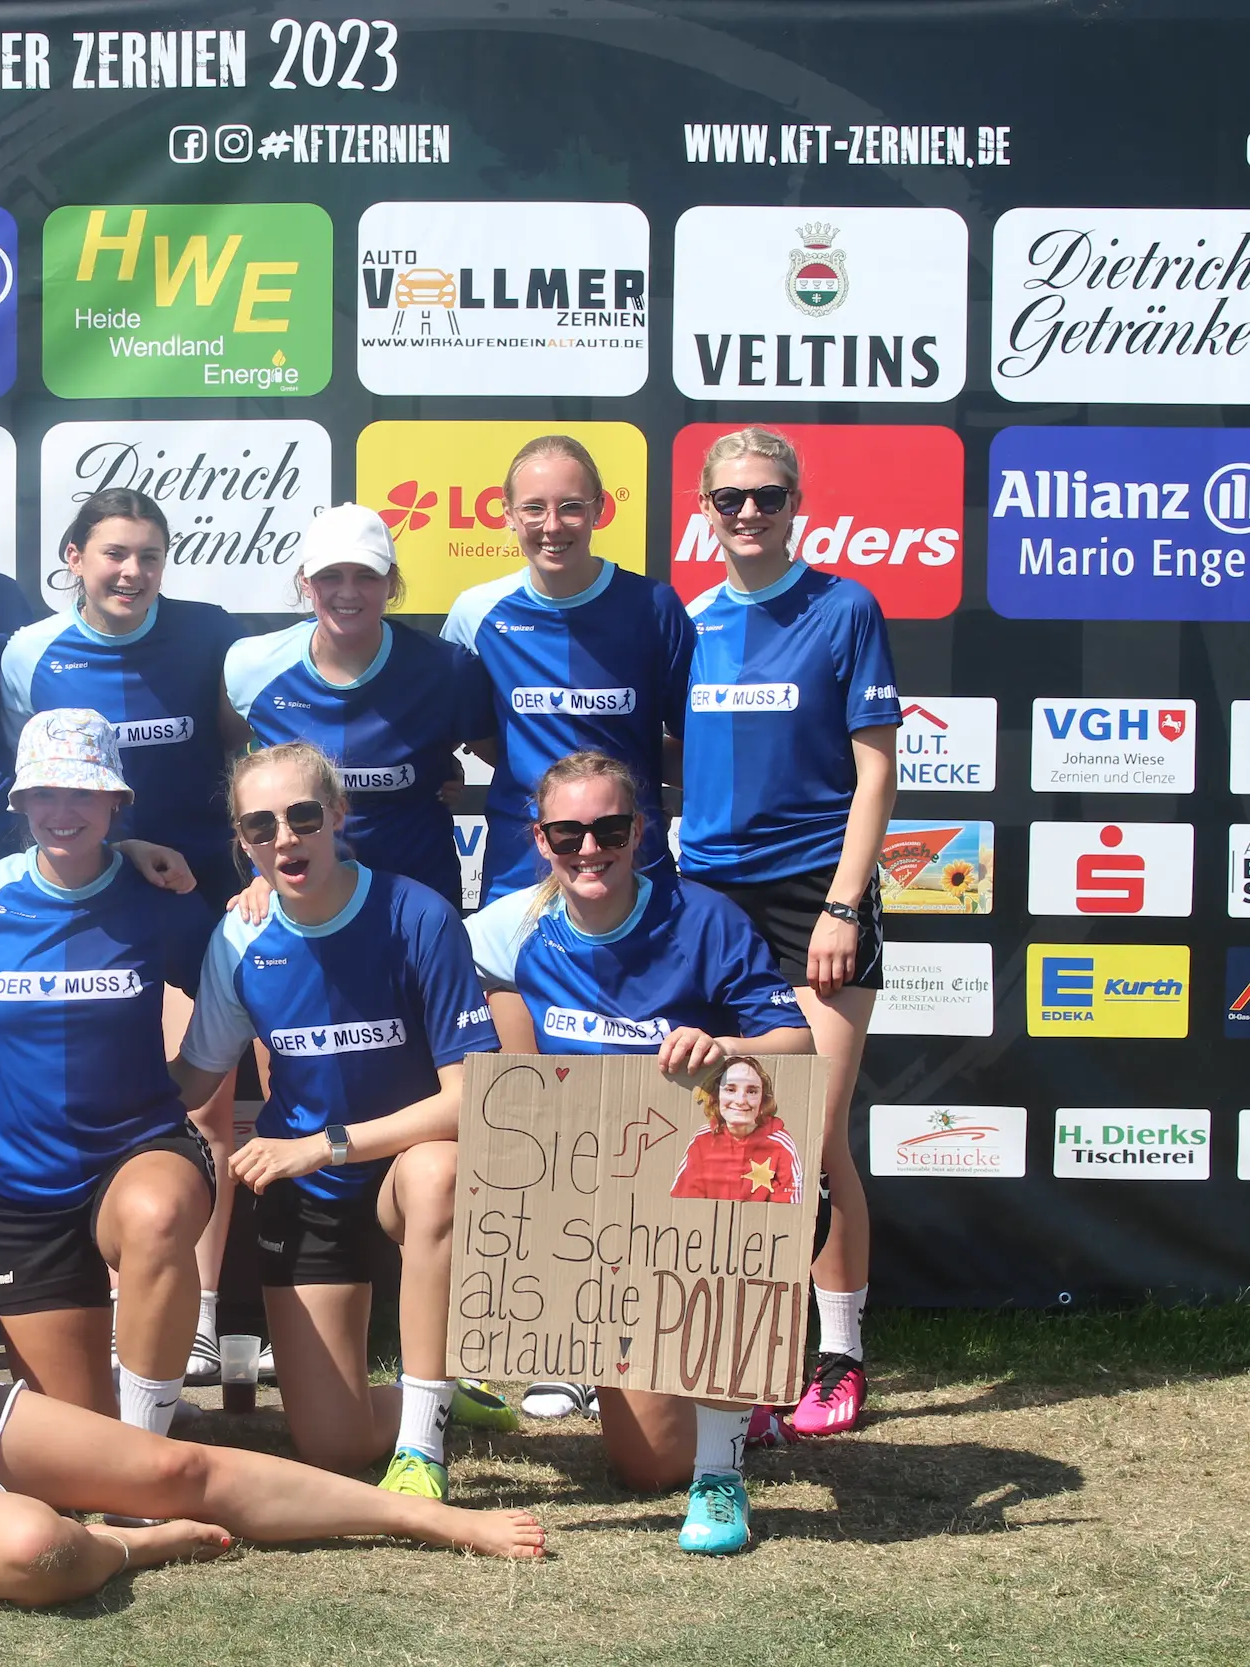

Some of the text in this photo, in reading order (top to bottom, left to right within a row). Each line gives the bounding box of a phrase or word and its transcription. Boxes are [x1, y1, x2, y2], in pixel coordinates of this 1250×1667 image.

[72, 30, 247, 89] ZERNIEN
[269, 19, 399, 92] 2023
[258, 124, 450, 164] #KFTZERNIEN
[684, 123, 1012, 169] WWW.KFT-ZERNIEN.DE
[362, 250, 418, 266] AUTO
[1023, 228, 1250, 293] Dietrich
[76, 208, 300, 334] HWE
[74, 308, 141, 330] Heide
[557, 311, 646, 328] ZERNIEN
[109, 335, 225, 358] Wendland
[361, 337, 645, 349] WWW.WIRKAUFENDEINALTAUTO.DE
[997, 295, 1250, 380] Getränke
[694, 333, 941, 389] VELTINS
[203, 362, 299, 390] Energie
[71, 441, 301, 503] Dietrich
[993, 470, 1190, 520] Allianz
[675, 516, 960, 567] Mlders
[1020, 536, 1246, 588] Mario Enge
[510, 623, 535, 633] spized
[64, 661, 89, 670] spized
[513, 692, 618, 711] DER MUSS
[692, 689, 776, 706] DER MUSS
[126, 724, 174, 742] MUSS
[1043, 708, 1149, 741] VGH
[1062, 752, 1165, 766] Johanna Wiese
[343, 771, 394, 789] MUSS
[900, 763, 981, 784] NECKE
[1050, 770, 1176, 785] Zernien und Clenze
[265, 957, 288, 967] spized
[883, 964, 942, 973] GASTHAUS
[64, 976, 121, 994] MUSS
[884, 976, 989, 993] eutschen Eiche
[1104, 978, 1183, 997] Kurth
[888, 1003, 936, 1011] ZERNIEN
[901, 994, 973, 1004] RESTAURANT
[546, 1012, 648, 1039] DER MUSS
[1041, 1012, 1095, 1021] EDEKA
[274, 1027, 386, 1053] DER MUSS
[473, 1065, 600, 1195] Sie
[1058, 1124, 1207, 1145] H. Dierks
[896, 1147, 1001, 1166] Steinicke
[1071, 1149, 1194, 1165] Tischlerei
[465, 1190, 790, 1279] ist schneller
[460, 1257, 802, 1403] als die POLIZEI
